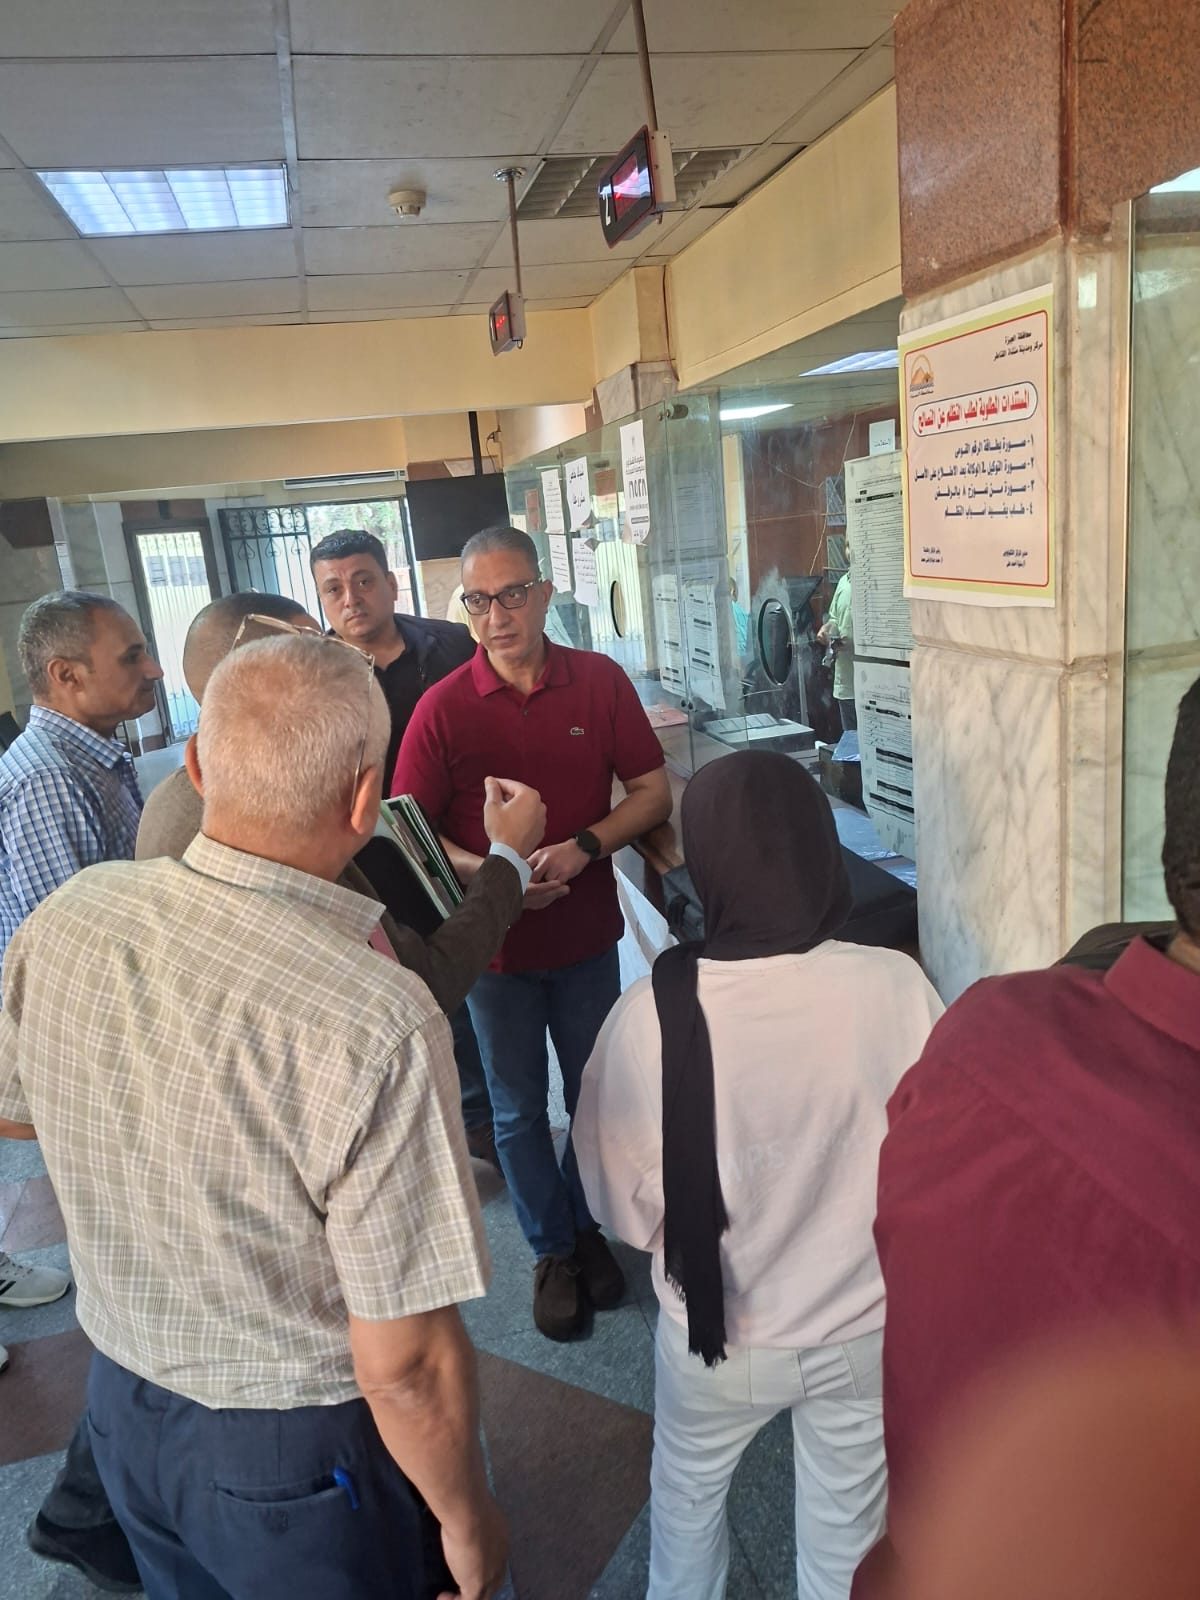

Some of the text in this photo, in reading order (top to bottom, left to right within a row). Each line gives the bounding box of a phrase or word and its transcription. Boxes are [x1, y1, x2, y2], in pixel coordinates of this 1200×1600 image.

[979, 394, 999, 421] المطلوبة
[1002, 389, 1029, 412] المستندات
[918, 408, 935, 433] التصالح
[964, 399, 978, 424] لطلب
[970, 440, 982, 456] الرقم
[1002, 437, 1026, 452] صورة
[1004, 459, 1026, 474] صورة
[1004, 481, 1026, 496] صورة
